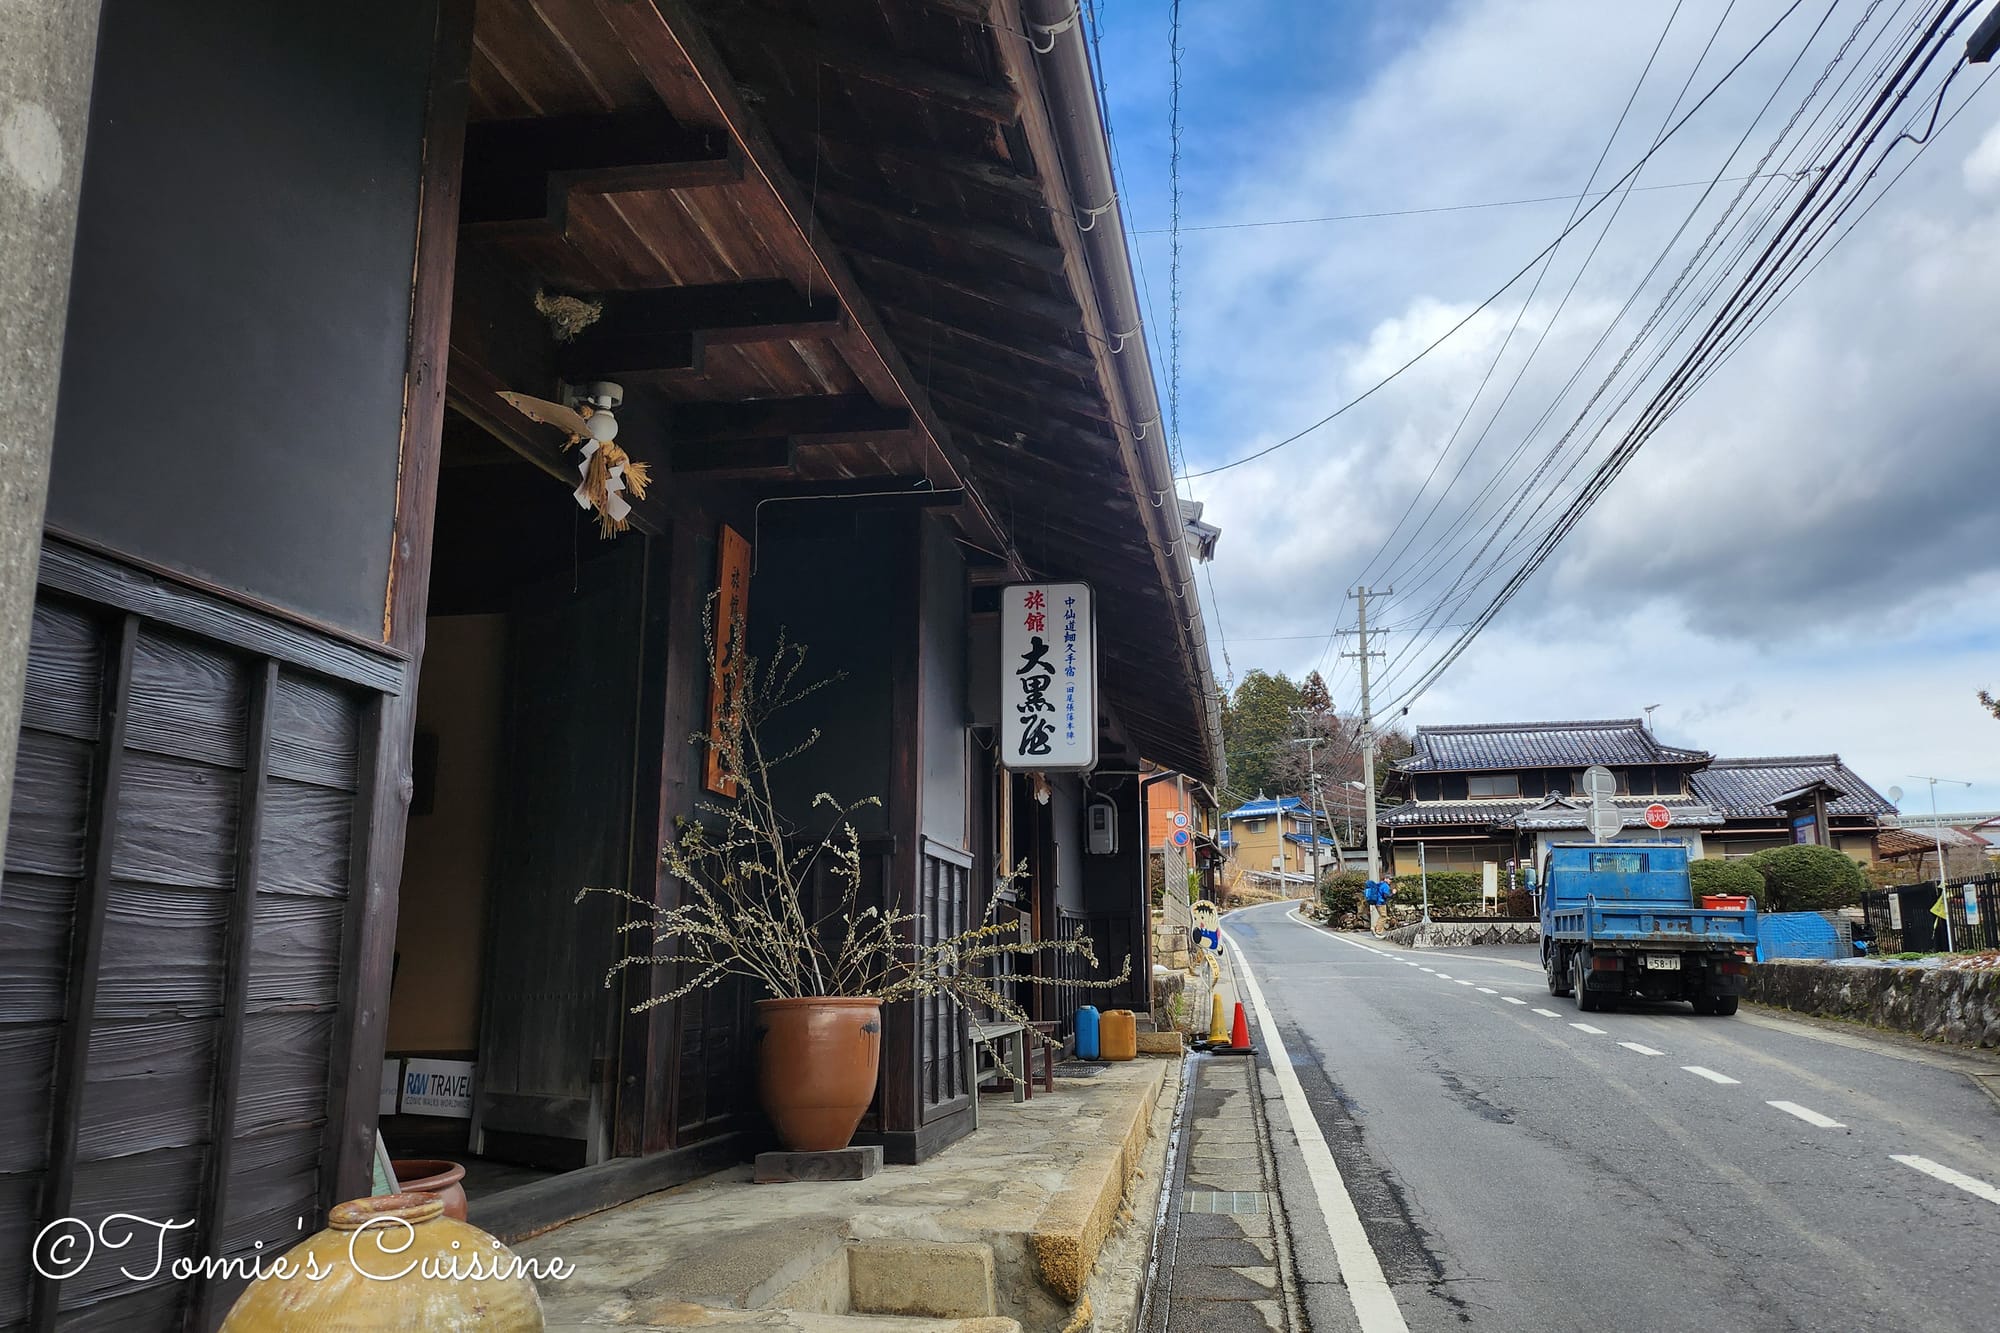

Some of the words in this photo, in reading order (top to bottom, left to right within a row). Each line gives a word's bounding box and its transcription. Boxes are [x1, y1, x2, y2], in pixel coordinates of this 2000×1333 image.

[1023, 589, 1046, 632] 旅館
[1016, 635, 1056, 756] 大黒屋
[406, 1072, 430, 1095] RAW
[431, 1074, 471, 1098] TRAVEL
